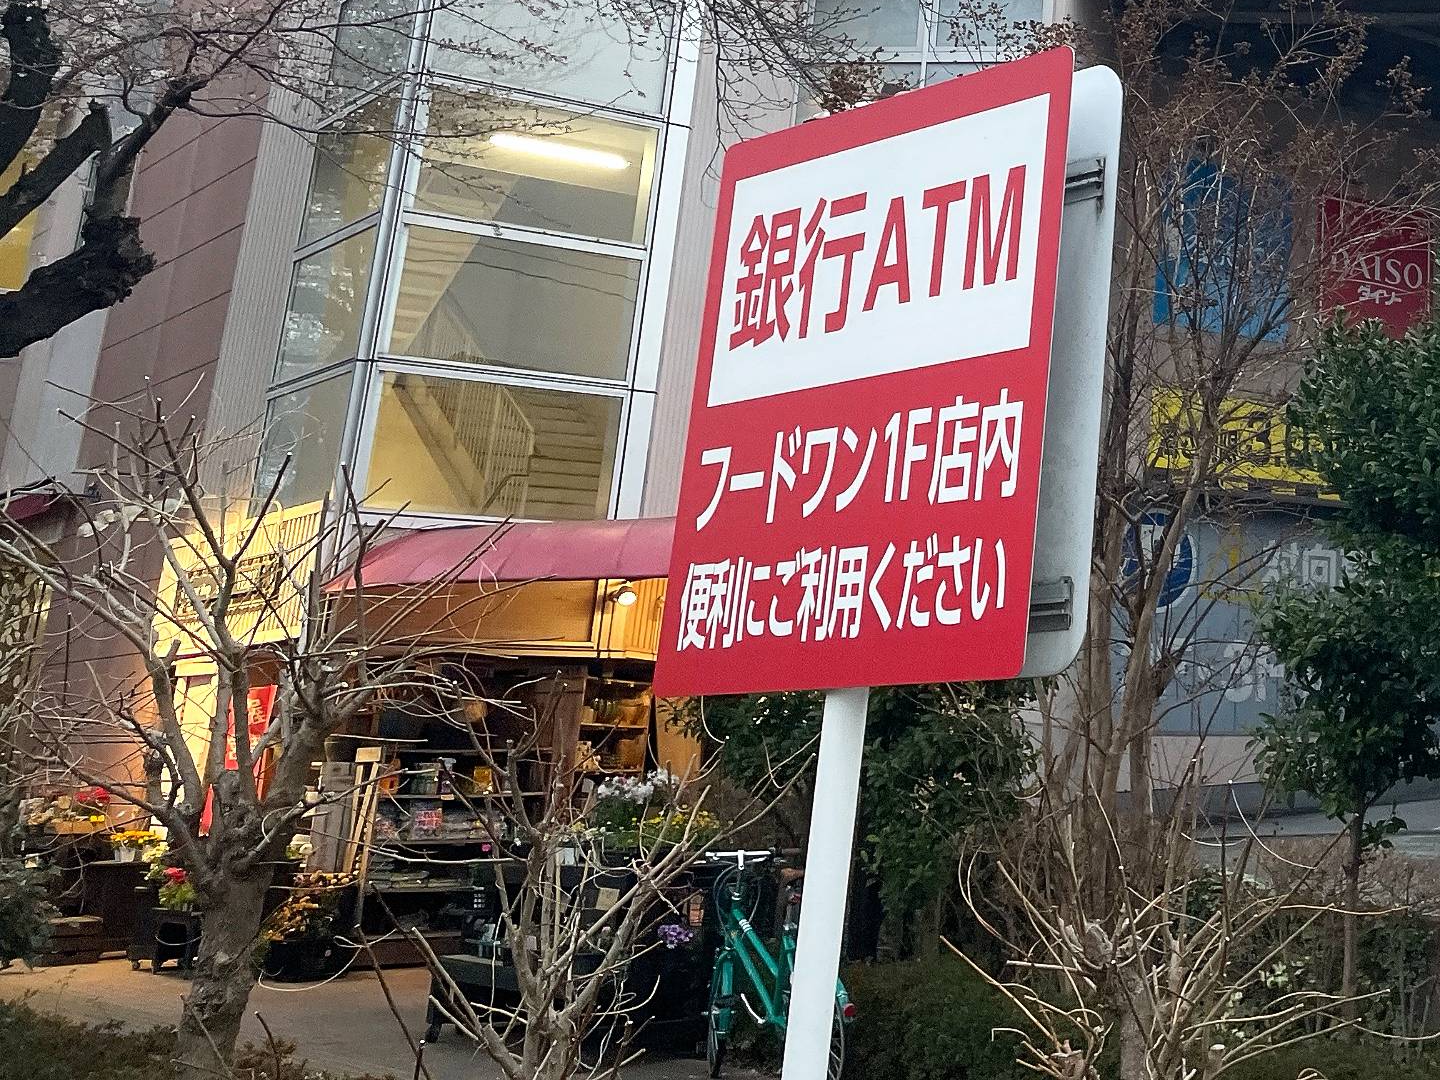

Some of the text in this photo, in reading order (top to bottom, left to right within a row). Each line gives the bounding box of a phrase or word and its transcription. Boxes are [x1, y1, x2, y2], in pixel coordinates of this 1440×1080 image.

[728, 164, 1028, 352] 銀行ATM
[696, 388, 1025, 532] フードワン1F店内
[677, 533, 1007, 651] 便利にご利用ください
